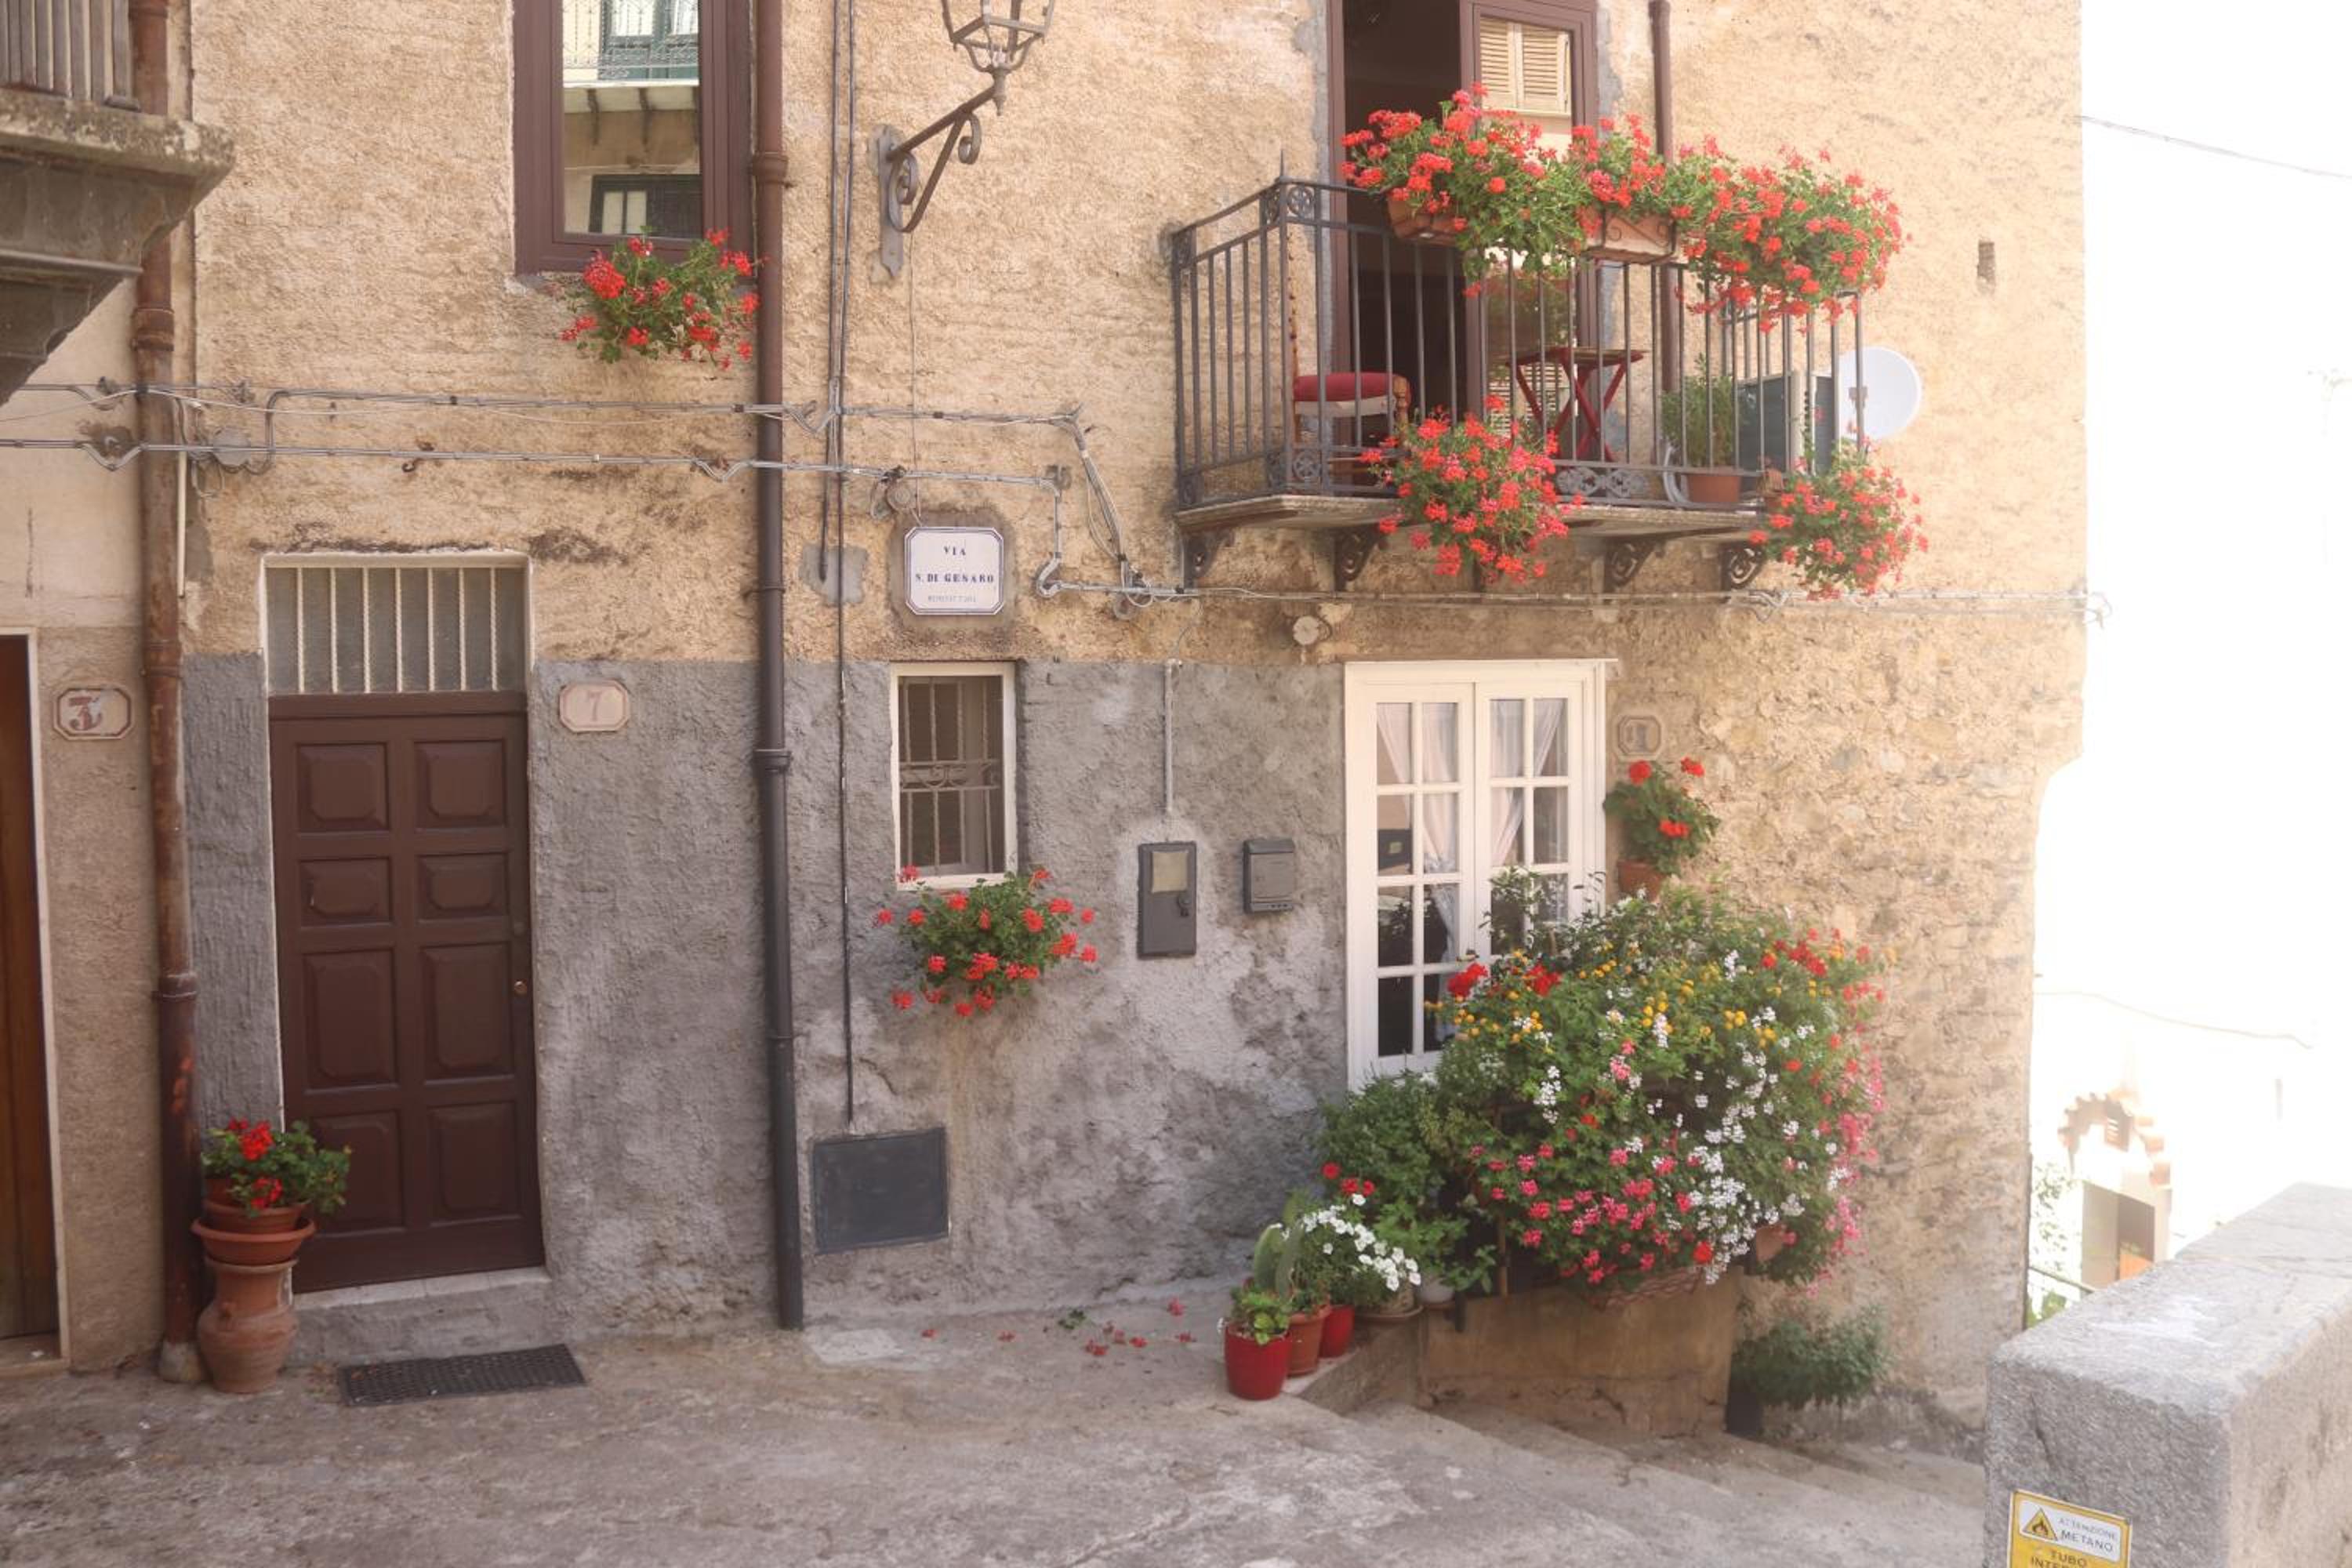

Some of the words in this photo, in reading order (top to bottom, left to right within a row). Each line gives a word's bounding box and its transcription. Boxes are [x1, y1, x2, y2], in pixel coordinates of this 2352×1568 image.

[944, 546, 966, 556] VIA
[927, 573, 938, 583] DI
[584, 691, 602, 722] 7
[2061, 1530, 2114, 1552] METANO
[2051, 1550, 2088, 1567] TUBO
